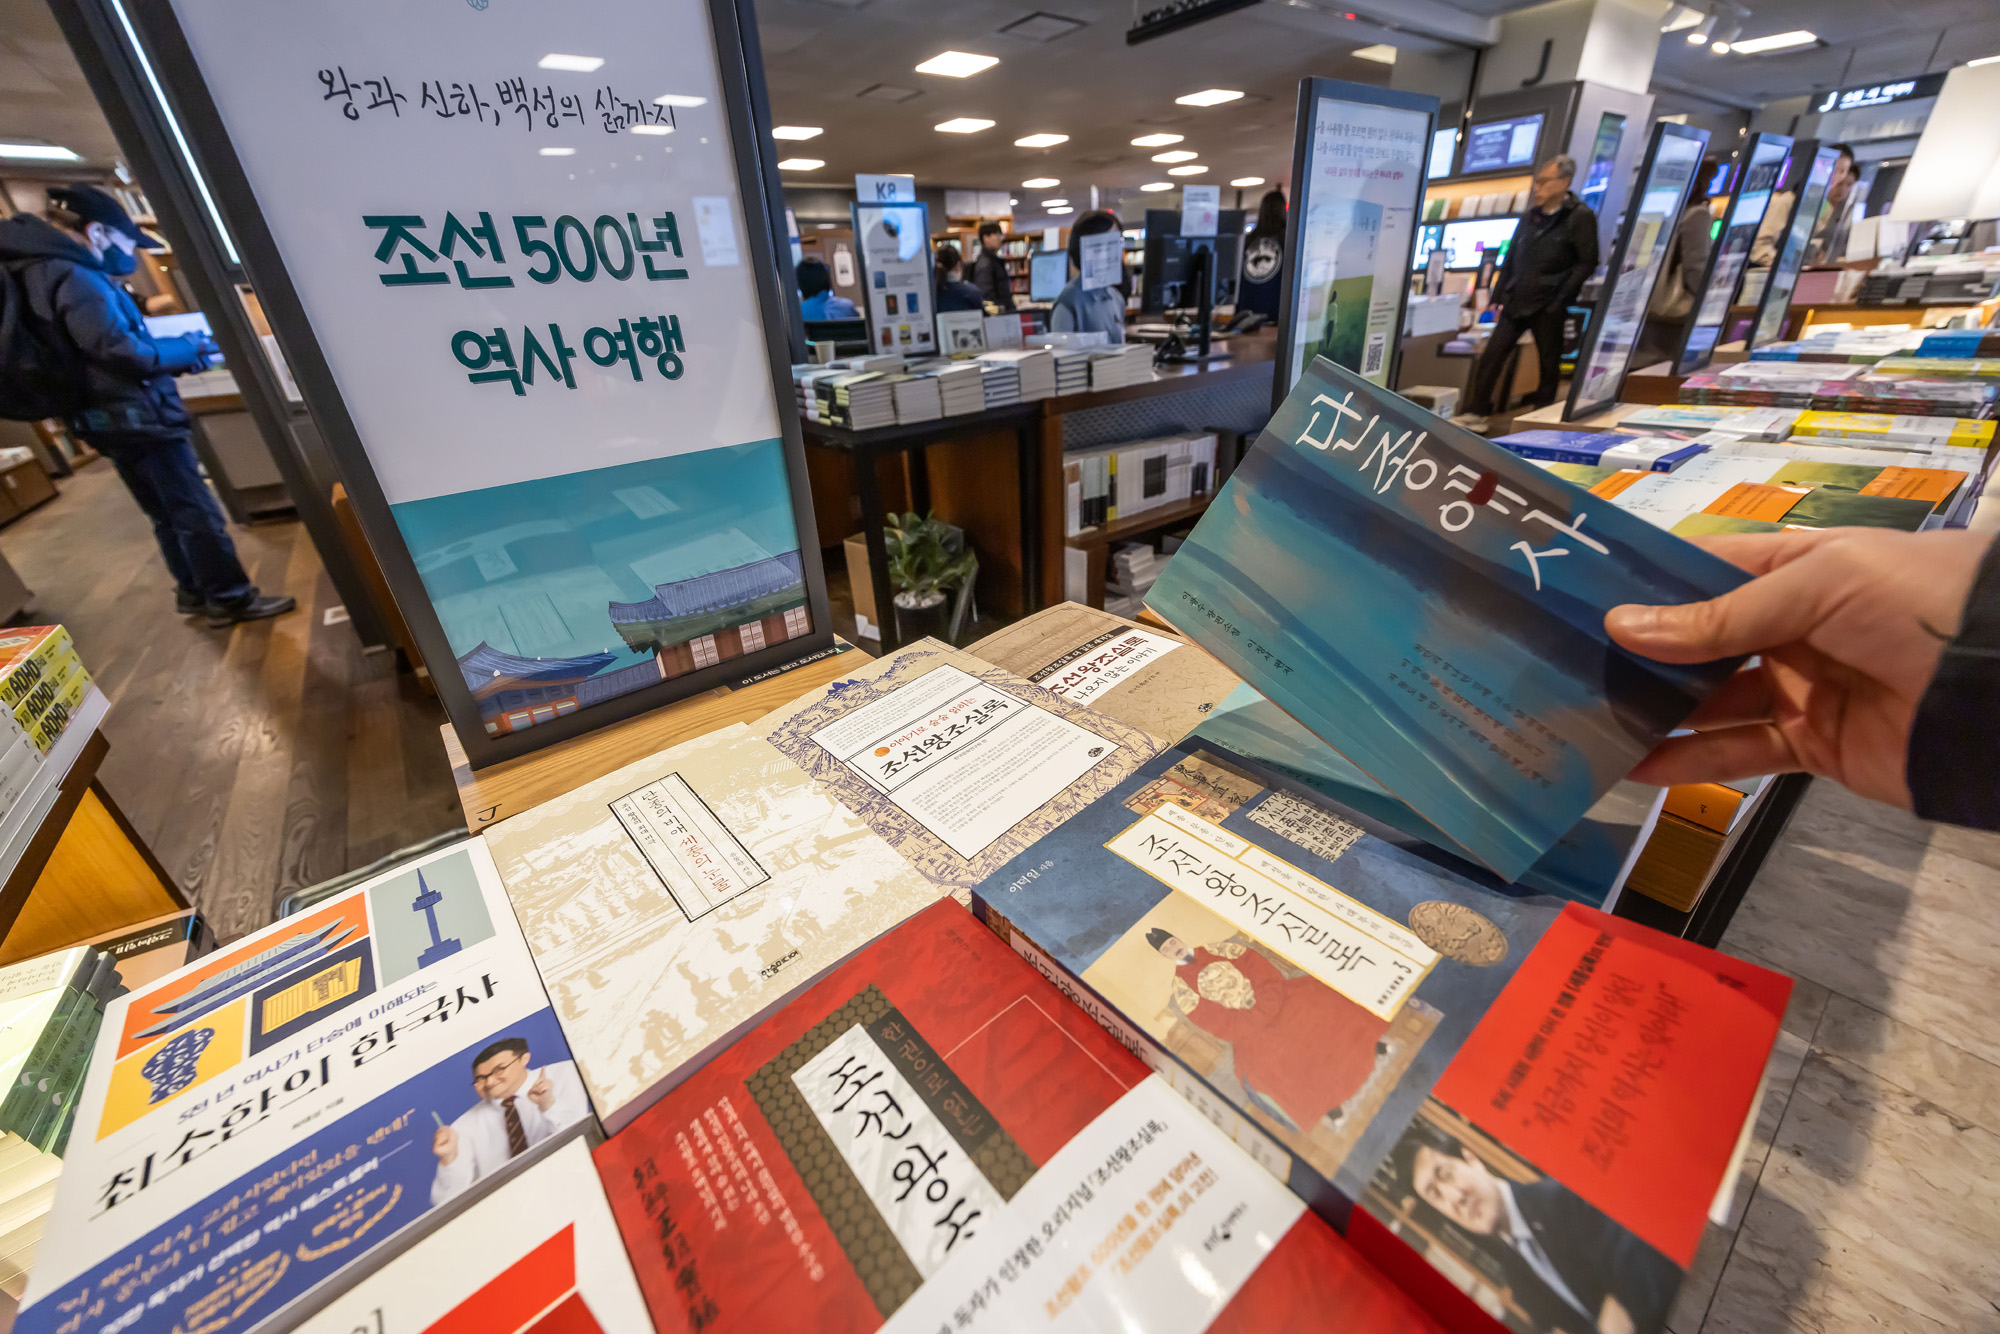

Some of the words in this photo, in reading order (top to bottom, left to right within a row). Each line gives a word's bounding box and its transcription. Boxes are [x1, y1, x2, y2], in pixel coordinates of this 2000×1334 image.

[318, 66, 407, 120] 왕과
[595, 86, 676, 133] 삶까지
[875, 181, 897, 199] K8
[362, 210, 515, 290] 조선
[512, 210, 689, 284] 500년
[451, 323, 577, 396] 역사
[583, 314, 686, 382] 여행
[1295, 391, 1610, 591] 단종애사
[8, 658, 41, 699] ADHD
[1049, 636, 1149, 695] 조선왕조실록
[1073, 677, 1109, 700] 나오지
[1104, 665, 1129, 680] 않는
[1127, 647, 1158, 664] 이야기
[25, 681, 55, 721] ADHD
[40, 702, 69, 742] ADHD
[880, 699, 1009, 780] 조선왕조실록
[890, 725, 928, 748] 이야기로
[679, 834, 712, 868] 세종의
[702, 867, 731, 893] 눈물
[1009, 868, 1041, 894] 이덕일
[1138, 833, 1377, 973] 조선왕조실록
[215, 1085, 236, 1105] 년
[242, 1050, 304, 1086] 역사가
[368, 981, 438, 1022] 이해되는
[88, 1055, 331, 1223] 최소한의
[350, 973, 500, 1069] 한국사
[881, 1021, 906, 1043] 한
[898, 1039, 950, 1097] 권으로
[942, 1089, 985, 1137] 읽는
